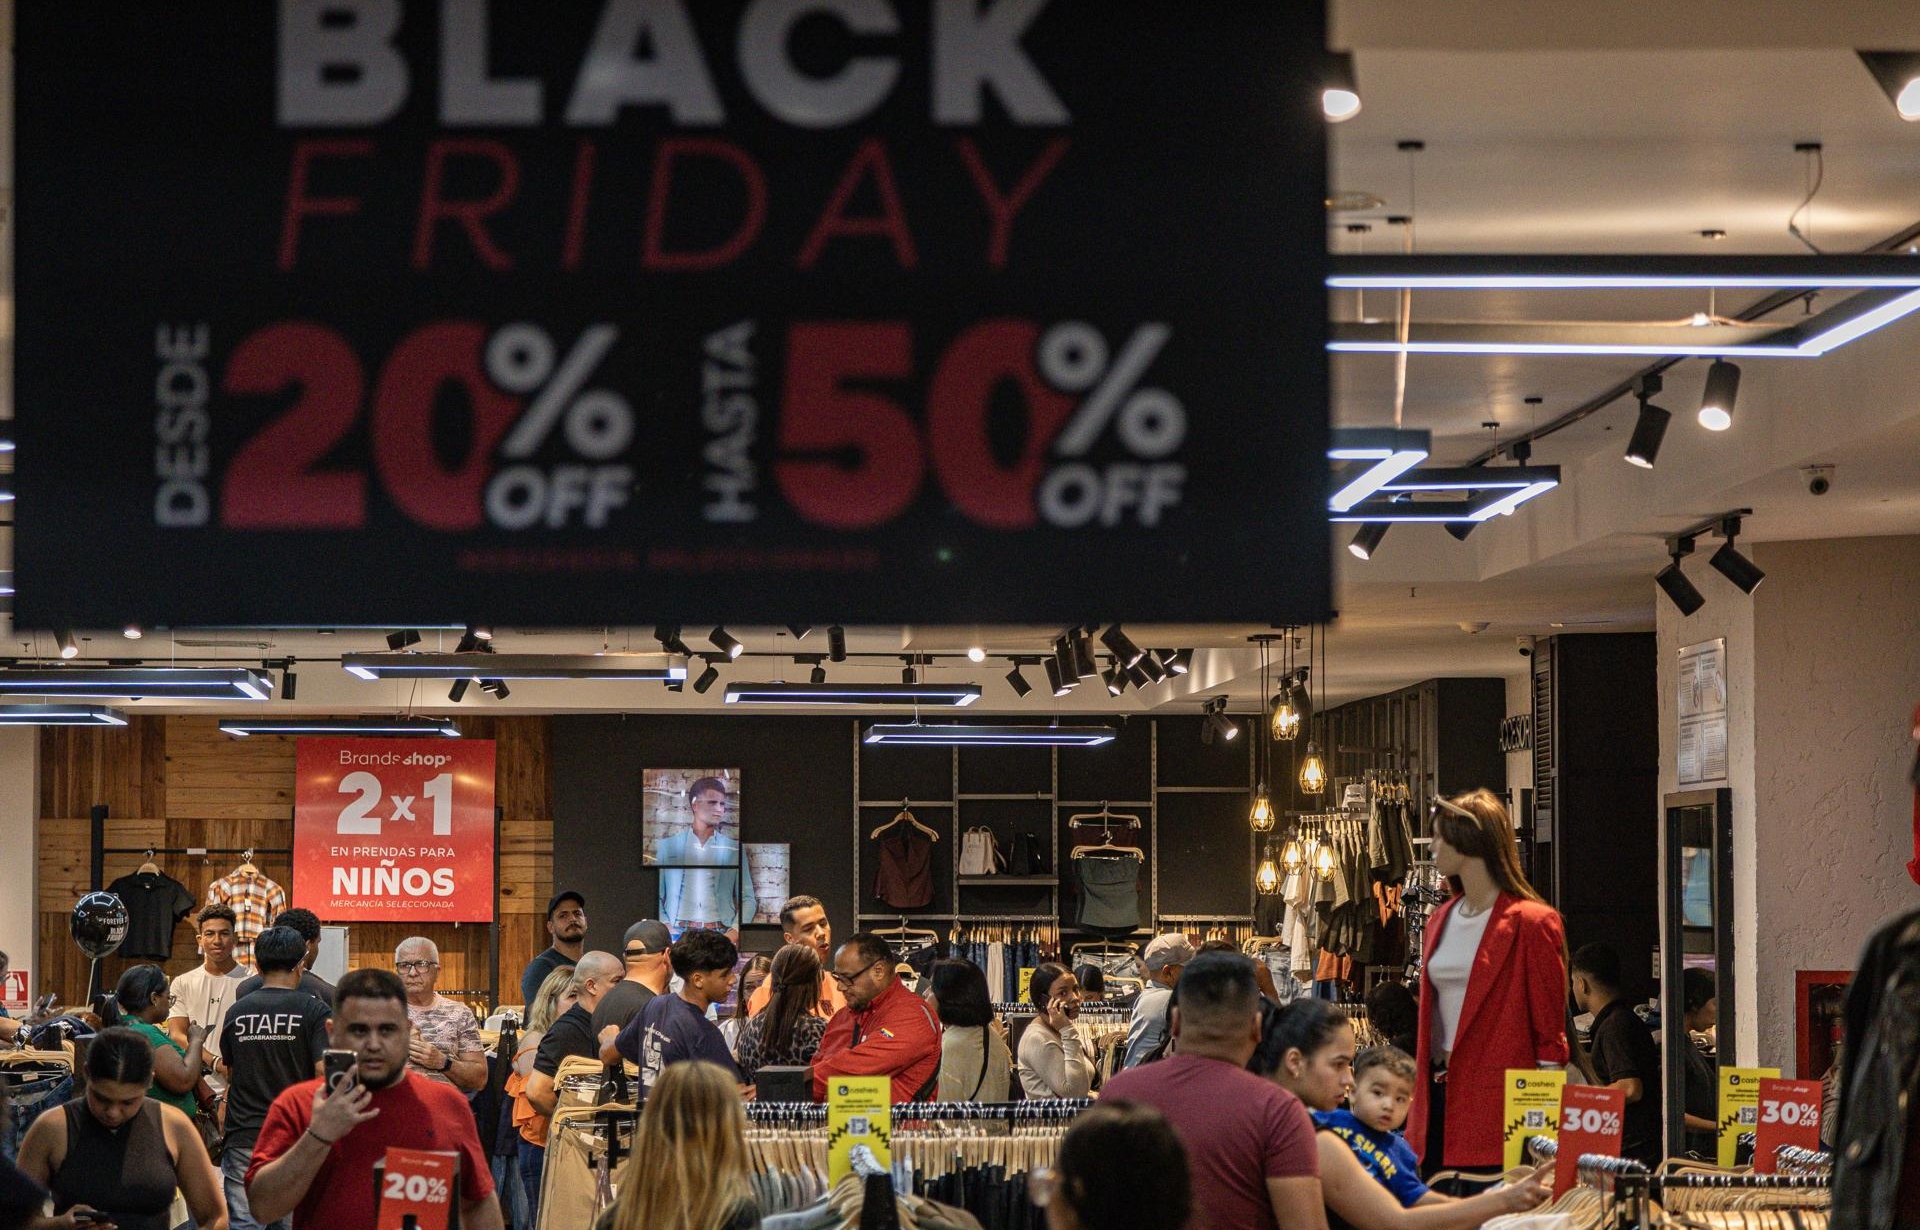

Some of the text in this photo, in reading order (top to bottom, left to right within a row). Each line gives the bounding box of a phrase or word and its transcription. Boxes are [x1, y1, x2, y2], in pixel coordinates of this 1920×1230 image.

[277, 0, 1072, 128] BLACK
[278, 136, 1072, 270] FRIDAY
[154, 322, 210, 528] DESDE
[219, 318, 636, 532] 20%
[703, 320, 758, 523] HASTA
[774, 317, 1188, 530] 50%
[485, 465, 632, 530] OFF
[1039, 464, 1188, 528] OFF
[331, 846, 456, 858] EN PRENDAS PARA
[332, 859, 455, 897] NIÑOS
[330, 899, 455, 909] MERCANCÍA SELECCIONADA
[235, 1013, 303, 1036] STAFF
[1562, 1107, 1620, 1133] 30%
[1761, 1100, 1818, 1125] 30%
[1799, 1119, 1818, 1127] OFF
[1600, 1127, 1619, 1135] OFF
[383, 1172, 448, 1202] 20%
[425, 1194, 447, 1203] OFF
